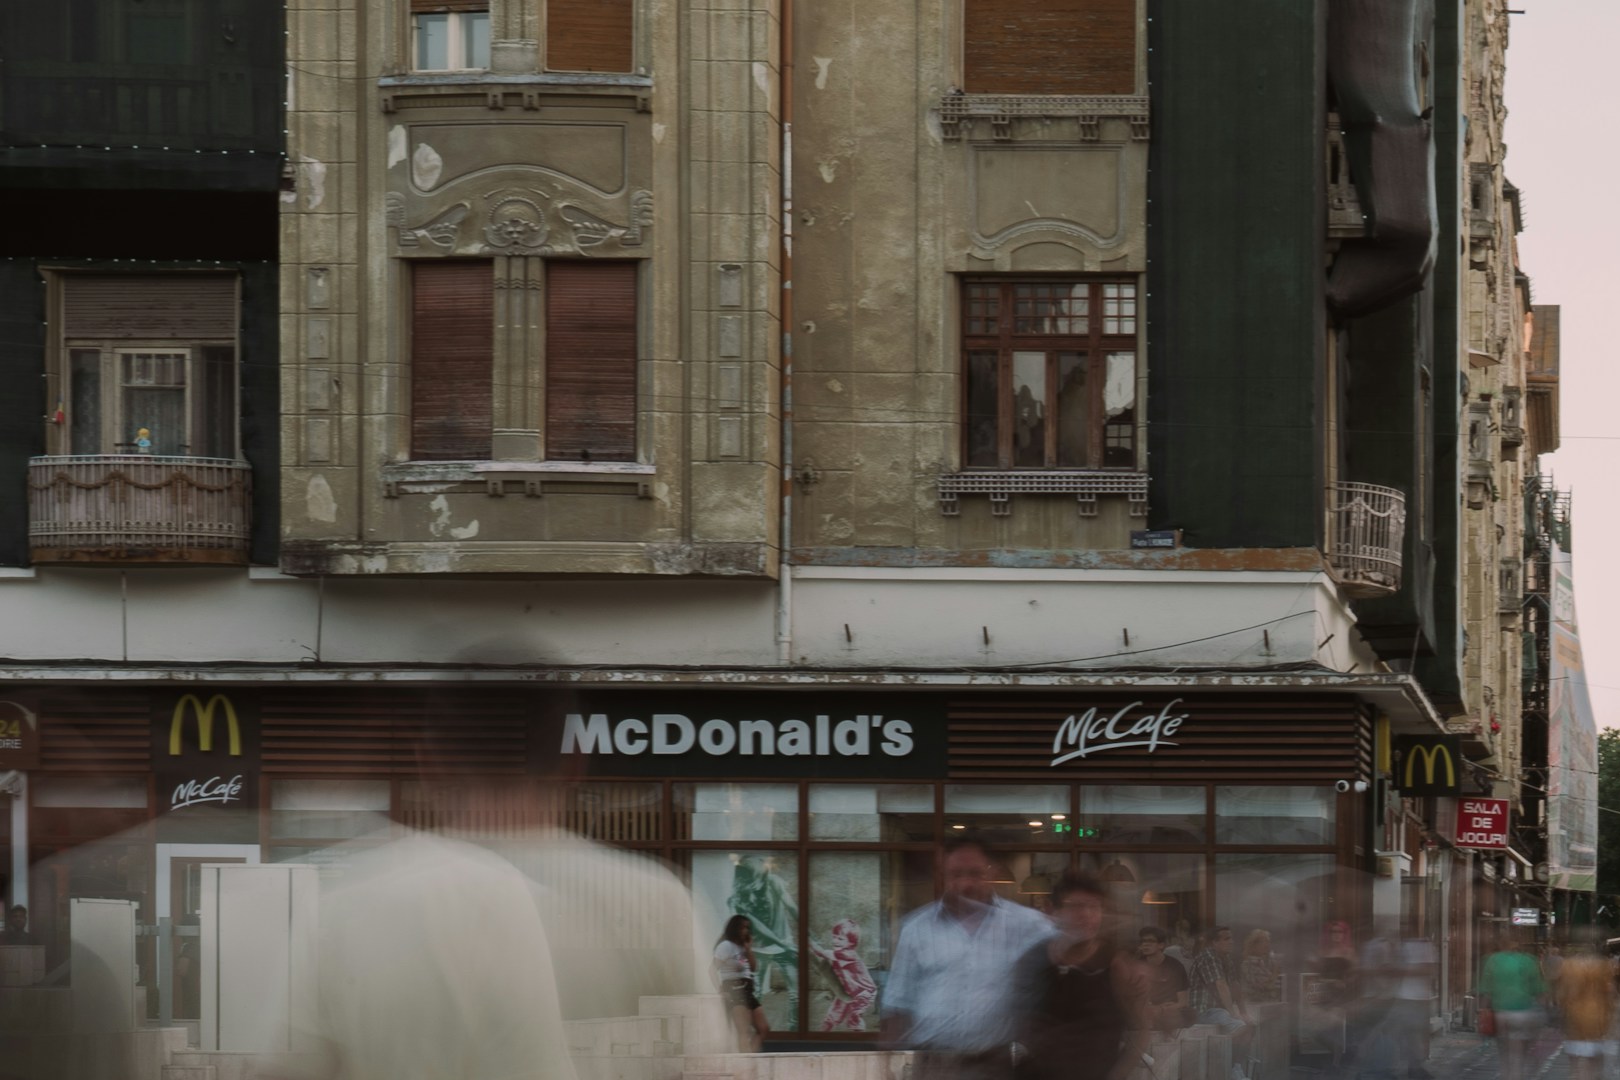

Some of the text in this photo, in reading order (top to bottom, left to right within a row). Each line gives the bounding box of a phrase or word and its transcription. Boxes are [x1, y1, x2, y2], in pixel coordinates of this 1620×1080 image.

[560, 713, 914, 756] McDonald's
[1051, 698, 1189, 762] McCafé
[171, 775, 243, 809] McCafé
[1463, 802, 1502, 815] SALA
[1472, 817, 1493, 829] DE
[1457, 832, 1507, 845] JOCURI
